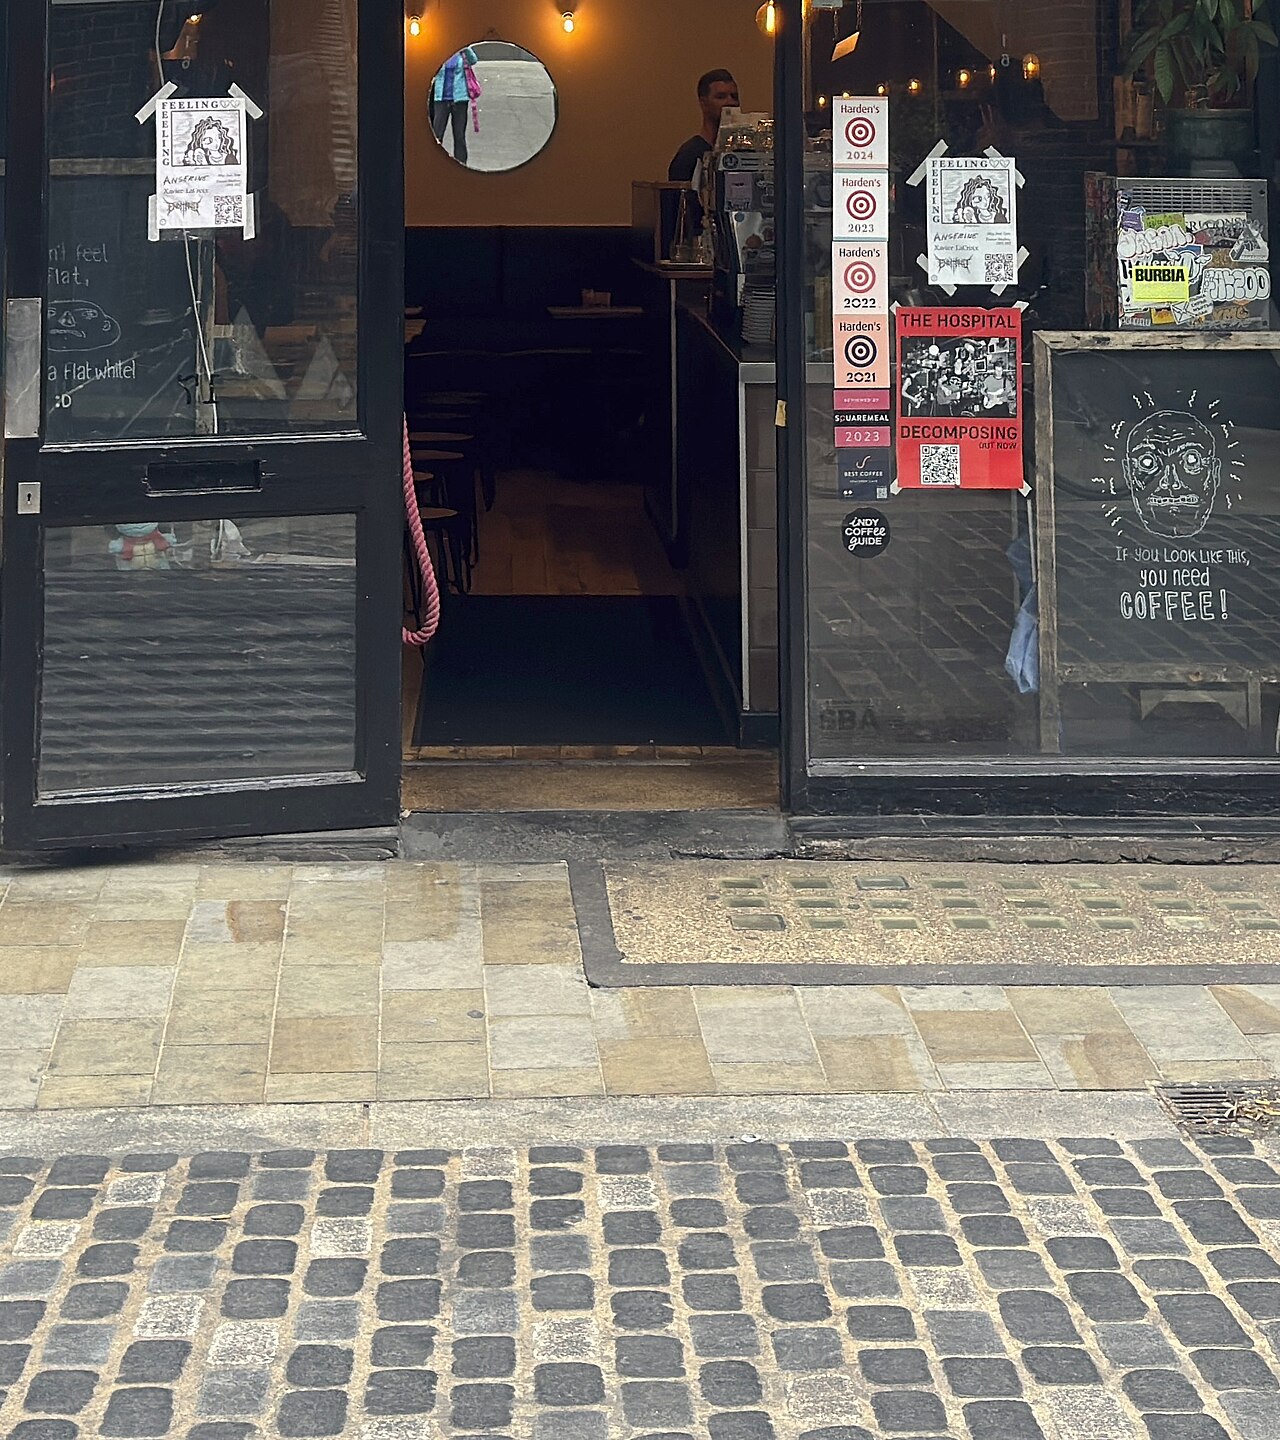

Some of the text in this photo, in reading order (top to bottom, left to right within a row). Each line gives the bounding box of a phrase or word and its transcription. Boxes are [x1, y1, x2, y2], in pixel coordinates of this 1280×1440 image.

[161, 101, 219, 109] FEELING
[840, 104, 880, 114] Harden's
[846, 151, 874, 160] 2024
[932, 160, 988, 168] FEELING
[842, 177, 881, 187] Harden's
[848, 223, 874, 233] 2023
[839, 247, 881, 258] Harden's
[1135, 268, 1185, 282] BURBIA
[844, 298, 876, 308] 2022
[839, 321, 881, 332] Harden's
[901, 313, 1017, 329] THE HOSPITAL
[846, 372, 876, 383] 2021
[834, 414, 890, 423] SQUAREMEAL
[845, 431, 881, 442] 2023
[901, 425, 1018, 440] DECOMPOSING
[978, 442, 1017, 450] OUT NOW
[1115, 546, 1128, 561] IF
[1164, 547, 1197, 563] LOOK
[1199, 550, 1224, 564] LIKE
[1139, 567, 1210, 588] you need
[1120, 589, 1228, 621] COFFEE!
